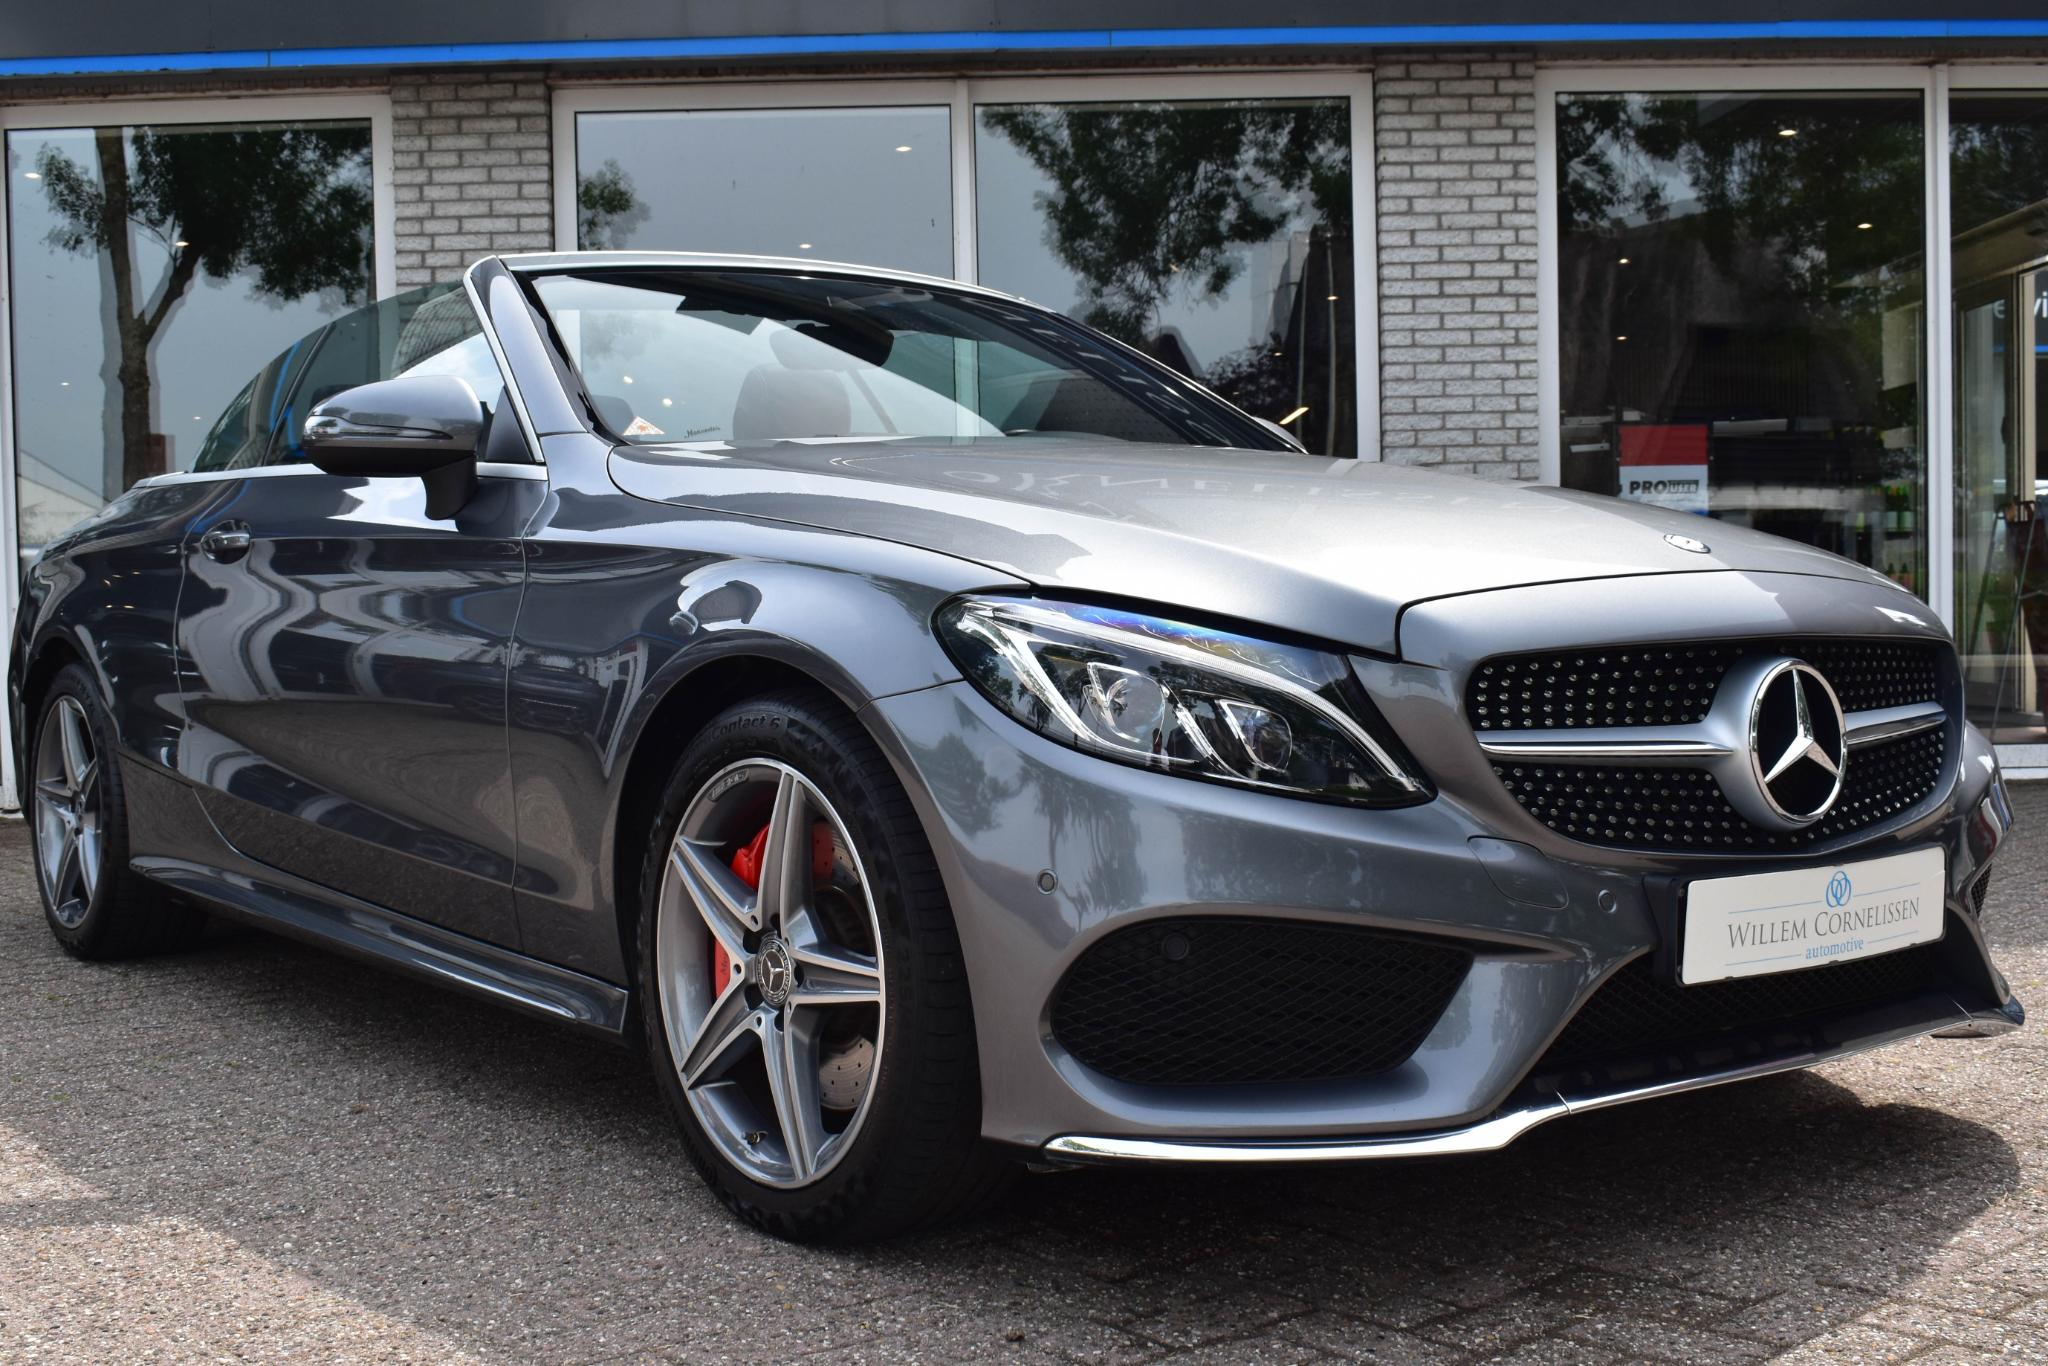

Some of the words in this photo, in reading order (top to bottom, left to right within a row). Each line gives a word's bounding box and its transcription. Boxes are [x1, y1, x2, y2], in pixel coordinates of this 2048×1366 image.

[1728, 920, 1807, 948] WILLEM
[1814, 897, 1919, 937] CORNELISSEN
[1805, 937, 1864, 960] automotive
